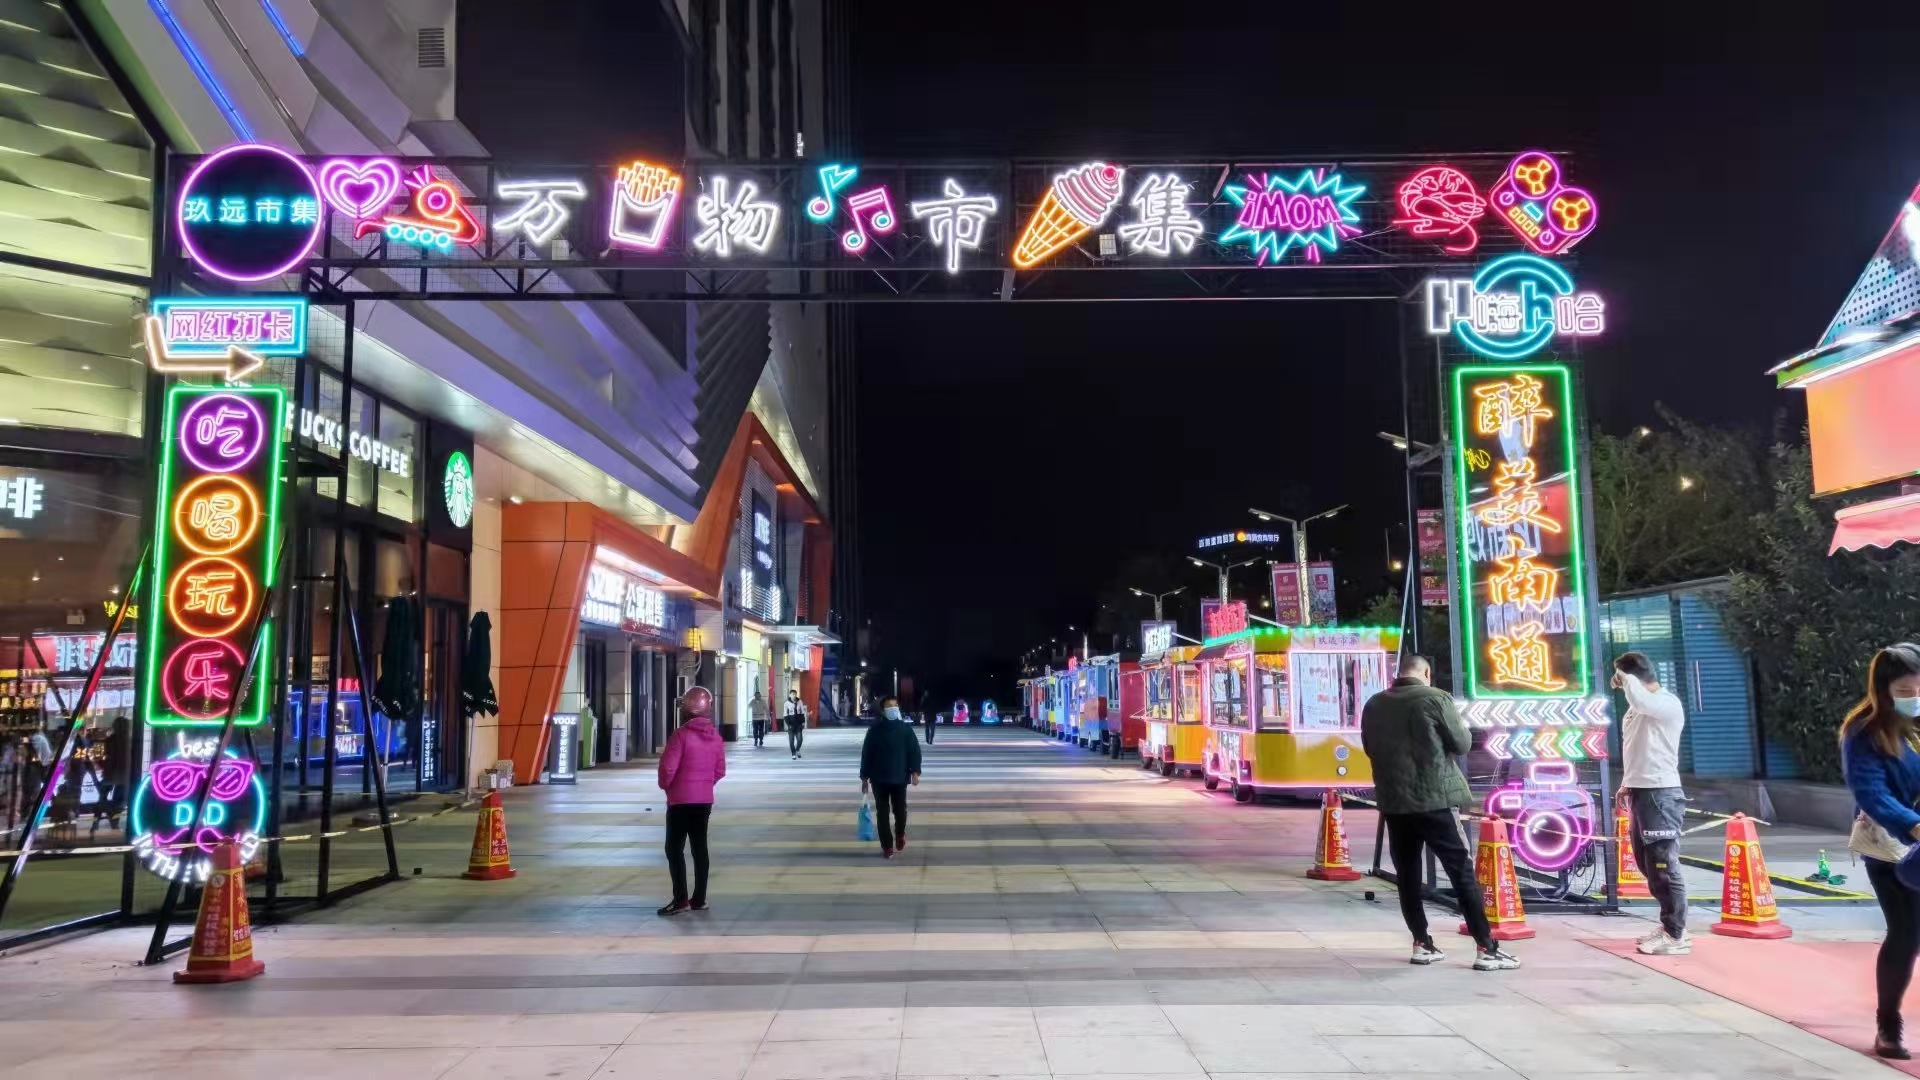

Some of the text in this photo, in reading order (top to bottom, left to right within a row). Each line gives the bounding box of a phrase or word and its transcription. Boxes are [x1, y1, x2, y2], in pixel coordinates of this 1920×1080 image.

[184, 197, 318, 224] 玖远市集
[170, 312, 293, 341] 网红打卡
[350, 431, 409, 478] COFFEE
[184, 406, 247, 699] 吃喝玩乐
[1318, 635, 1358, 646] 玖远市集
[552, 717, 577, 726] YOOZ
[177, 731, 220, 758] bes
[175, 803, 225, 826] DD
